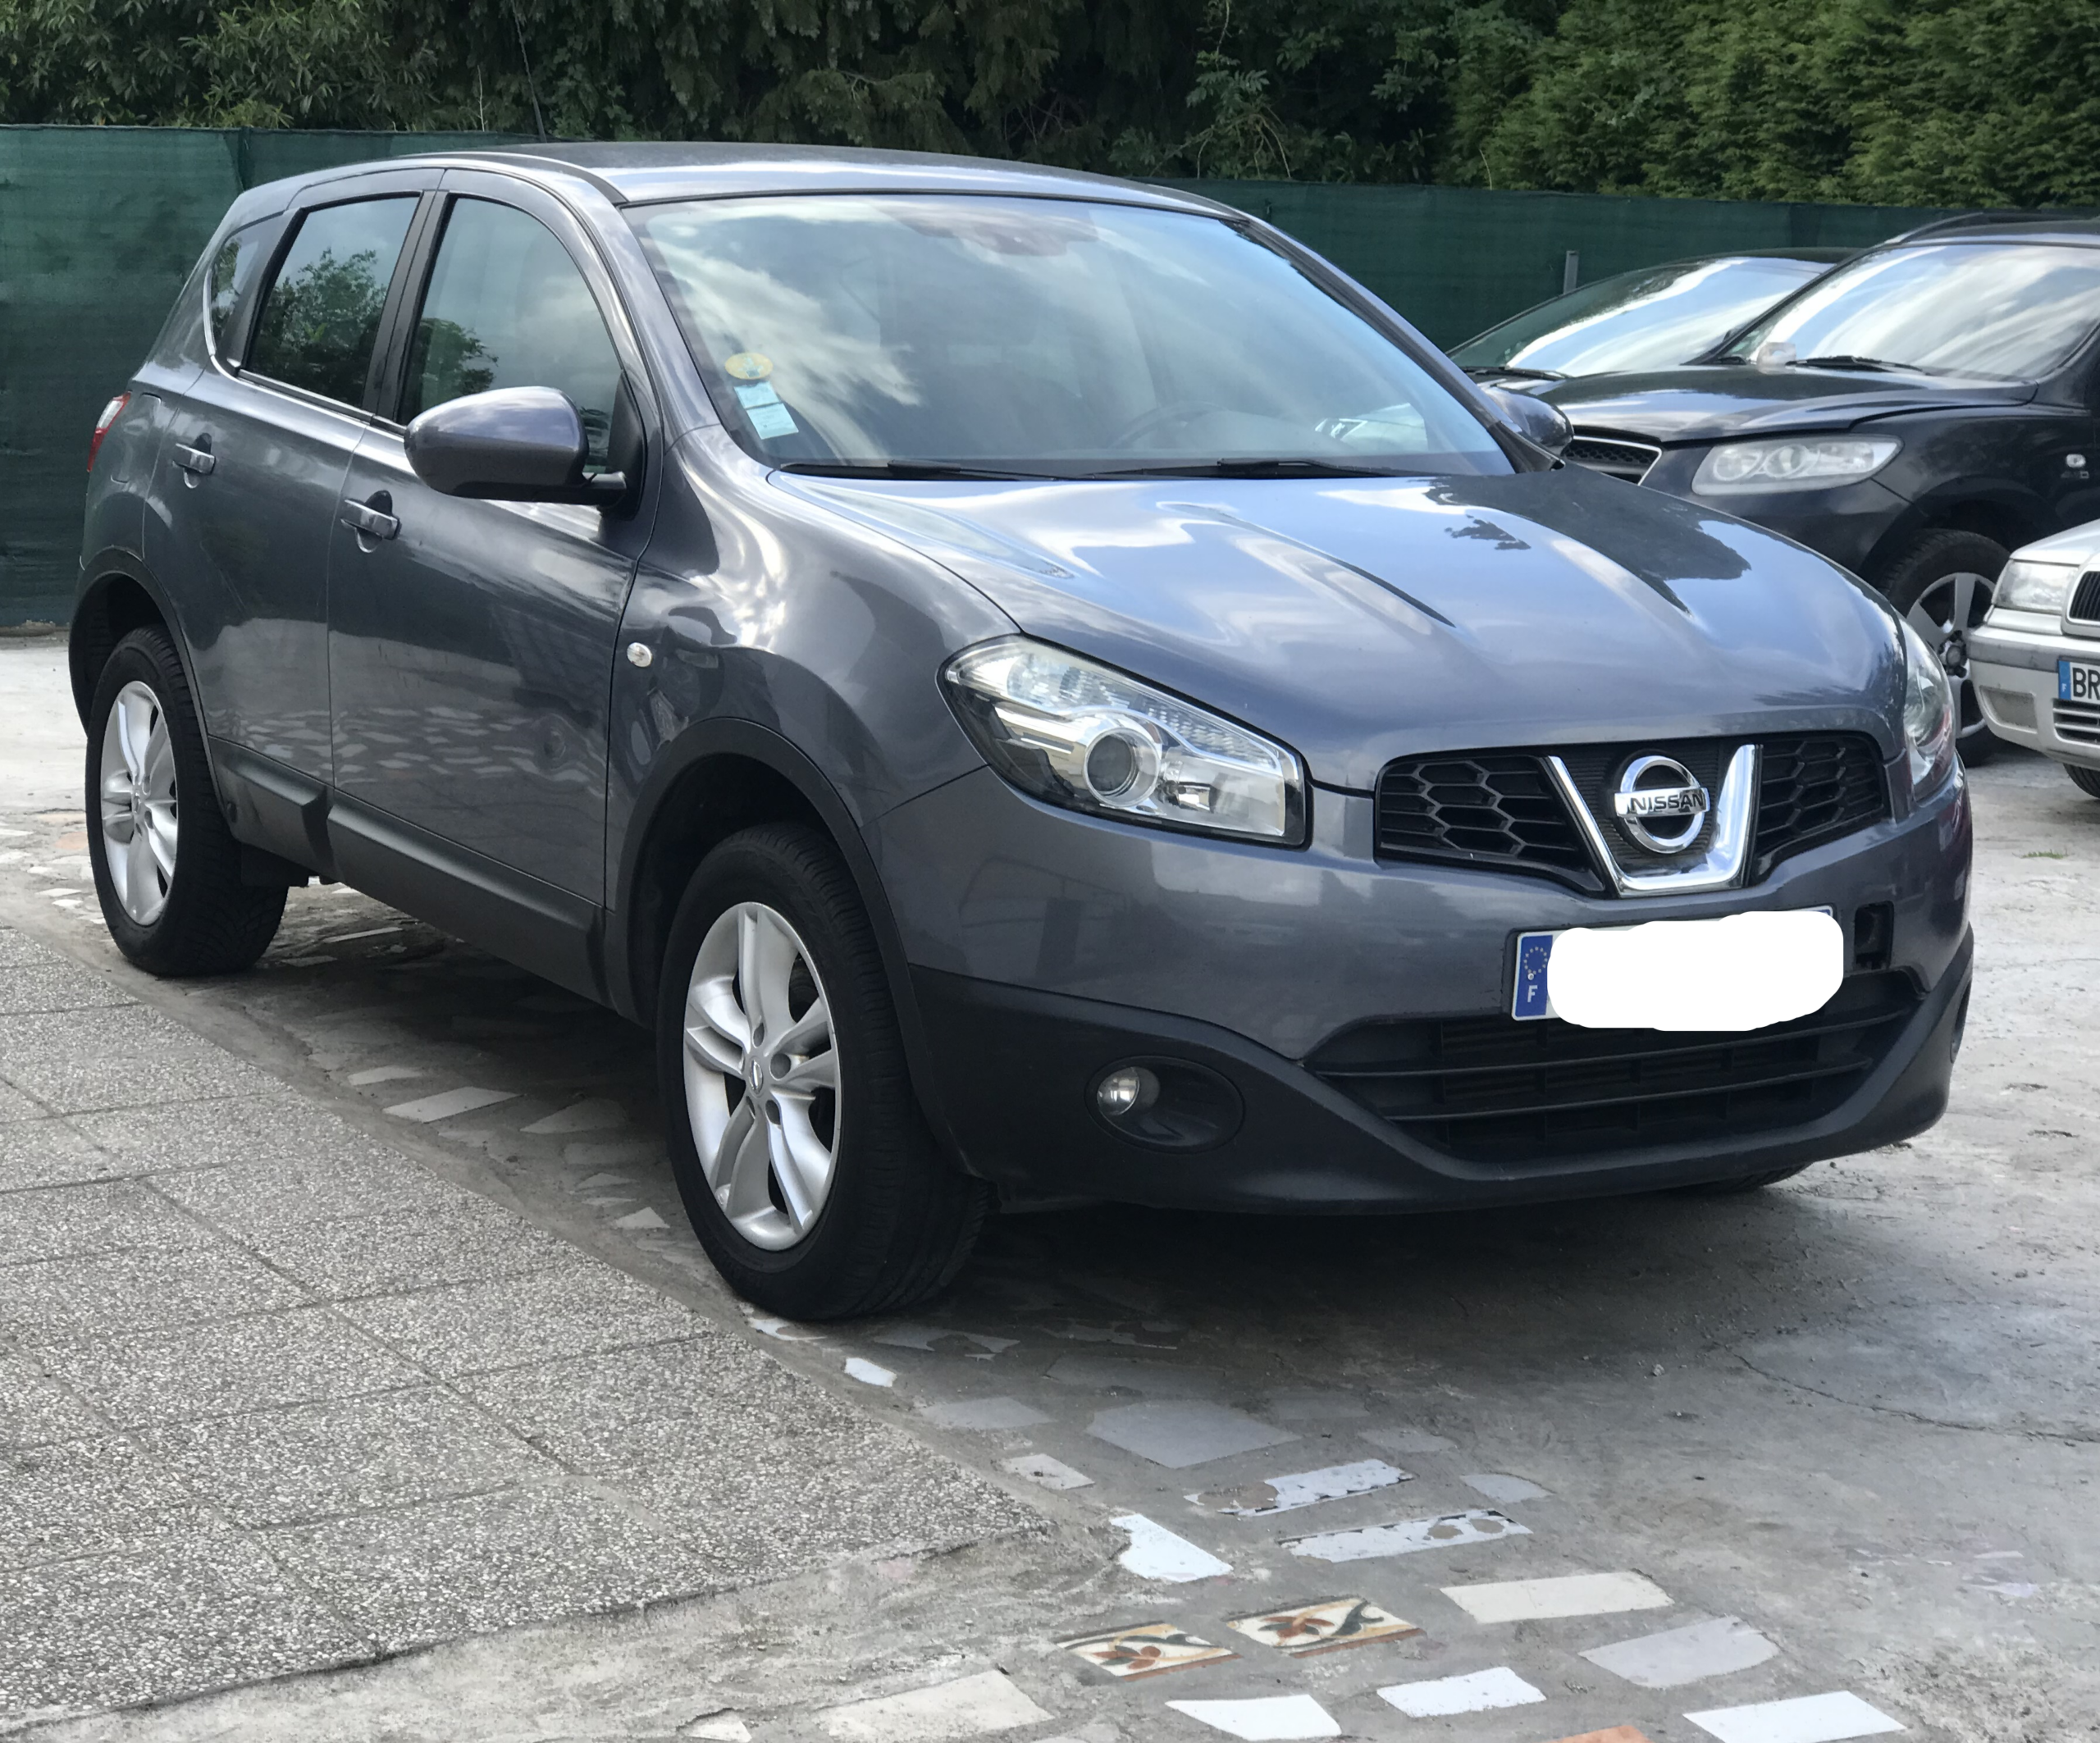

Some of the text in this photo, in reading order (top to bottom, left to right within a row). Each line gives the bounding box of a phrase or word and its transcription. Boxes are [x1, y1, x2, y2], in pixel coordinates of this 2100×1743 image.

[2072, 667, 2100, 700] BR
[1630, 792, 1705, 810] NISSAN
[1527, 985, 1538, 1002] F
